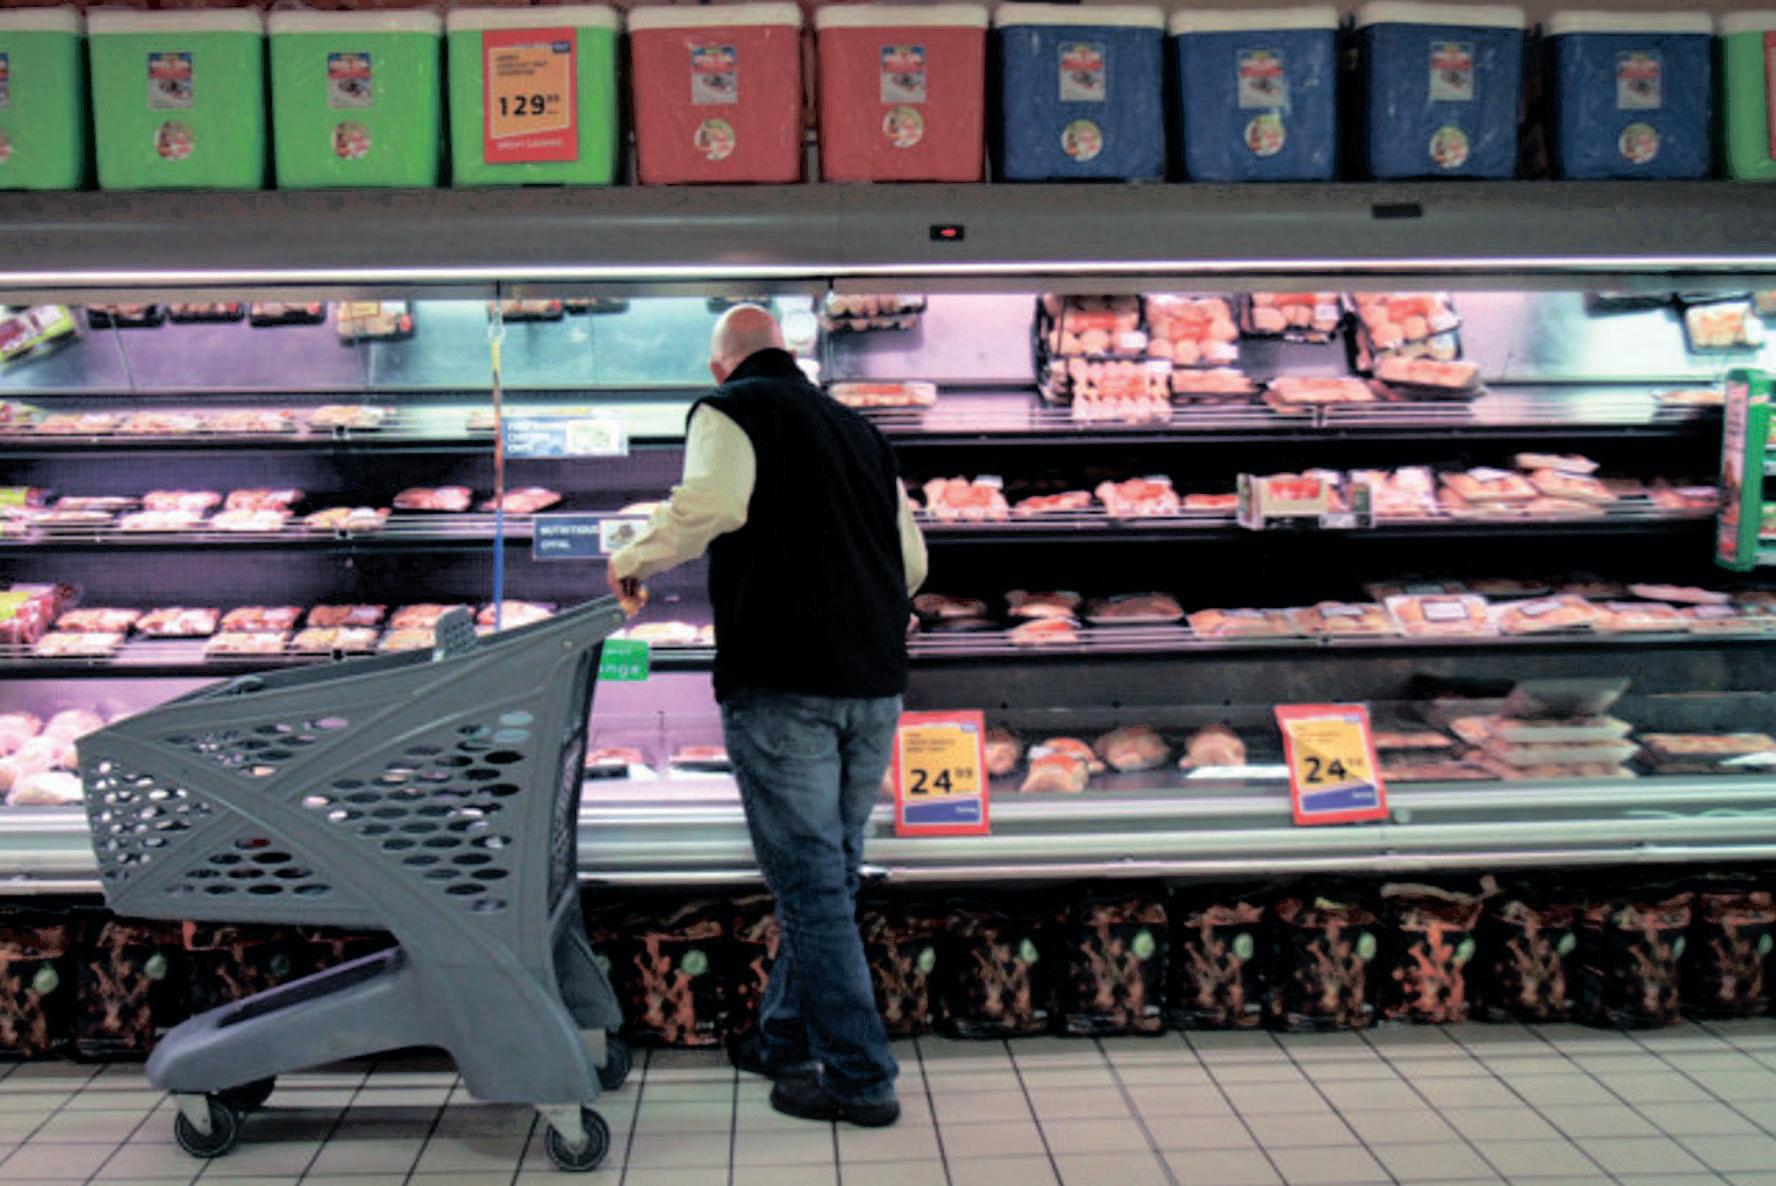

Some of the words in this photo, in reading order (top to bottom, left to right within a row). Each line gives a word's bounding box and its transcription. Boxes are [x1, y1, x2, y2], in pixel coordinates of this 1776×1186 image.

[499, 95, 545, 116] 129
[910, 768, 953, 795] 24
[1304, 756, 1347, 783] 24
